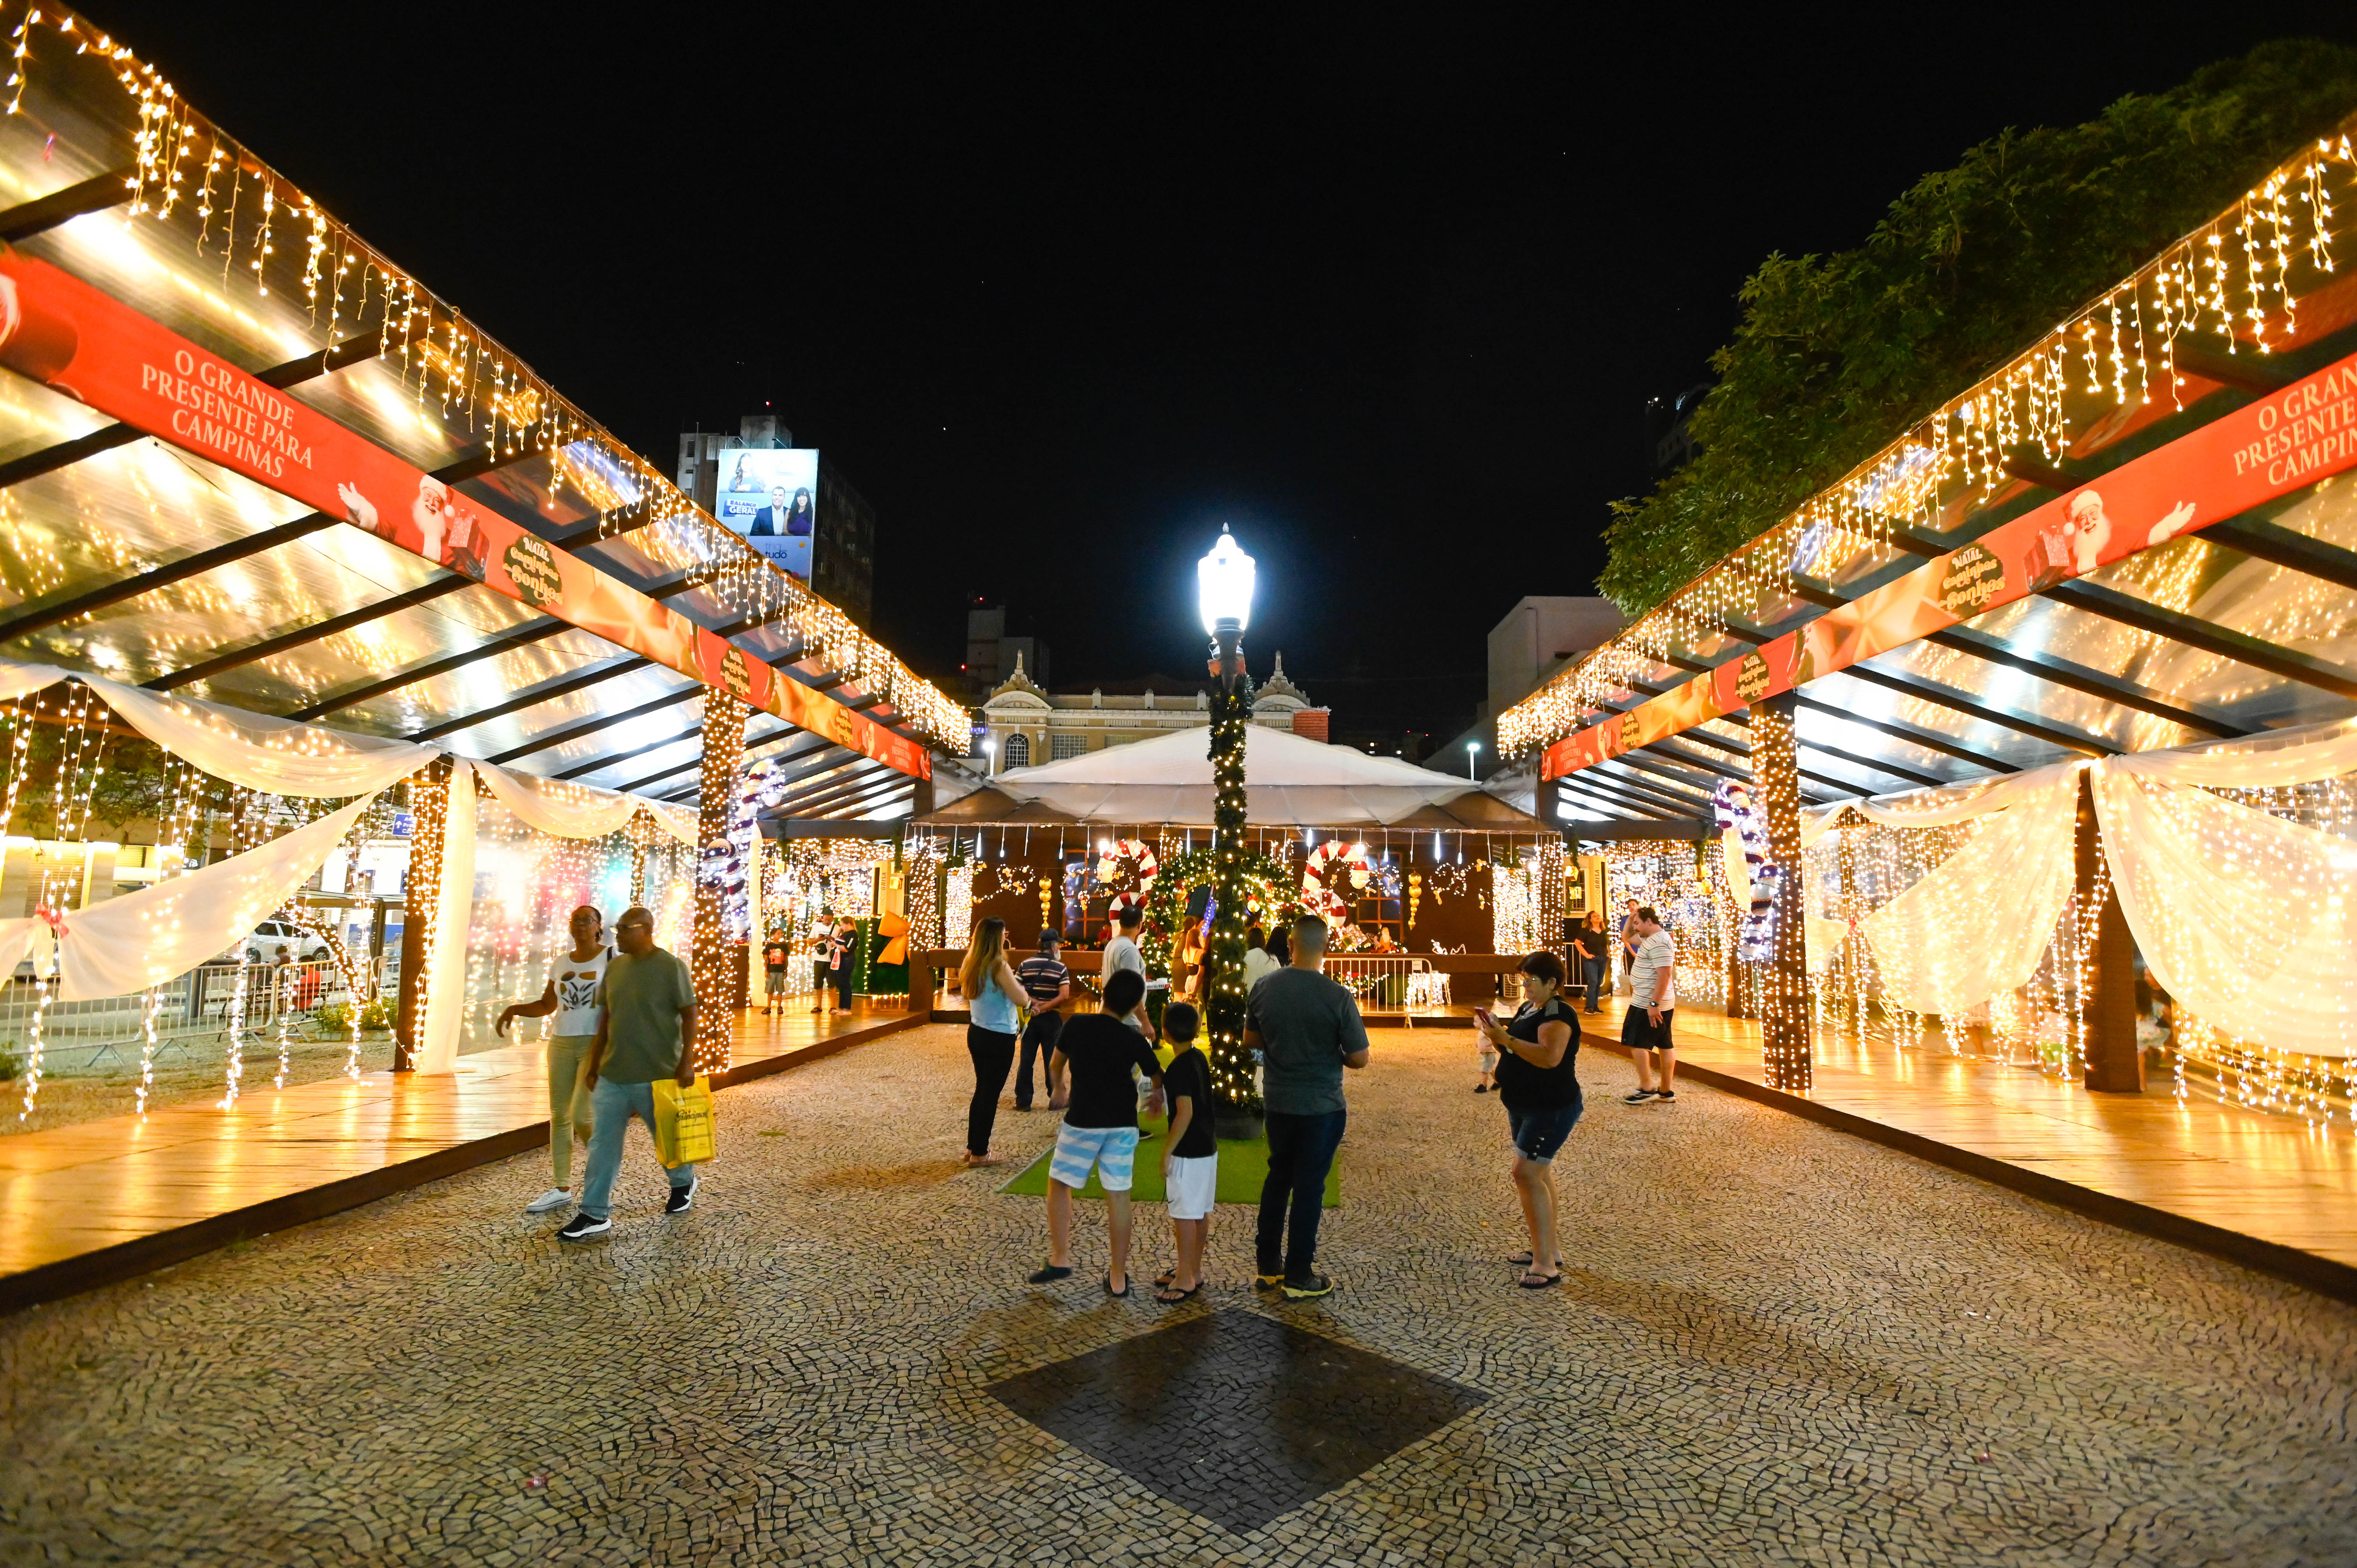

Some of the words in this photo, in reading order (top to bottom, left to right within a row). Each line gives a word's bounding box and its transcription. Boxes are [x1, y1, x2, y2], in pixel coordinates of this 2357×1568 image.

[175, 350, 193, 376] O
[200, 362, 294, 429] GRANDE
[142, 363, 257, 436] PRESENTE
[261, 420, 311, 470] PARA
[2258, 405, 2277, 431] O
[172, 409, 284, 477] CAMPINAS
[2233, 396, 2356, 476] PRESENTE
[729, 506, 756, 514] GERAL
[511, 547, 559, 581] Caminhos
[523, 537, 549, 562] NATAL
[765, 550, 787, 558] tudo
[1952, 547, 1983, 570] NATAL
[512, 565, 564, 605] Sonhos
[1943, 559, 1997, 590] Caminhos
[1947, 577, 2005, 610] Sonhos
